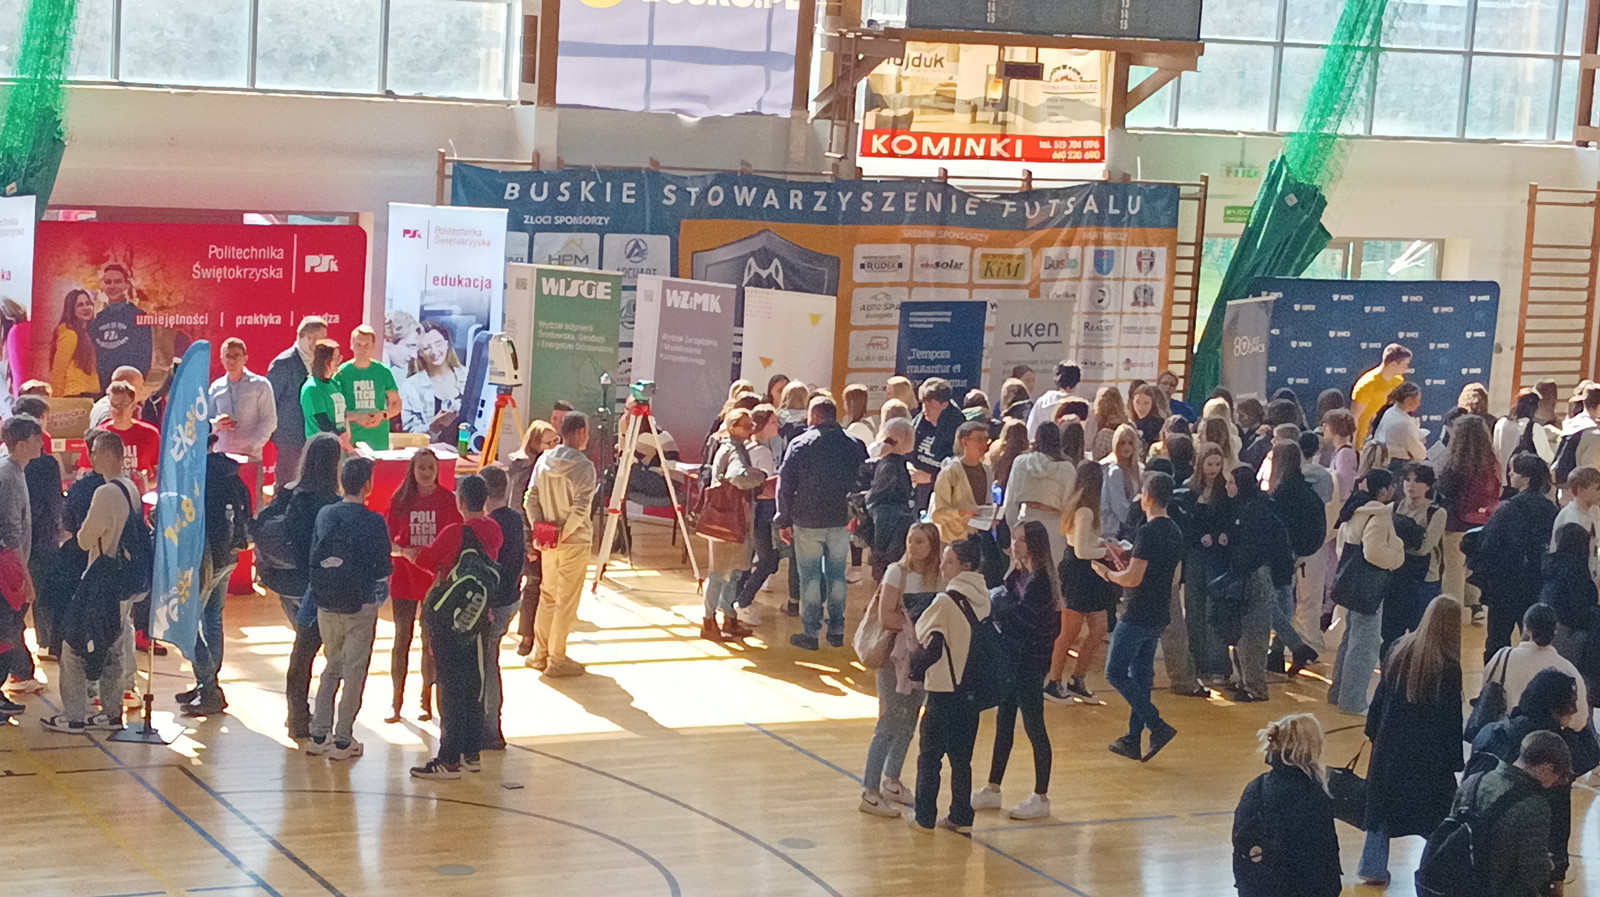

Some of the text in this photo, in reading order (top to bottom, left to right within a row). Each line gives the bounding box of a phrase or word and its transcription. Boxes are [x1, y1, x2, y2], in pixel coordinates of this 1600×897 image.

[871, 134, 1023, 158] KOMINKI
[504, 181, 1142, 218] BUSKIE STOWARZYSZENIE FUTSALU
[554, 215, 610, 226] SPONSORZY
[208, 245, 284, 260] Politechnika
[547, 254, 589, 266] HPM
[191, 261, 283, 283] Świętokrzyska
[432, 273, 492, 291] edukacja
[136, 312, 209, 328] umiejętności
[236, 311, 282, 327] praktyka
[1010, 322, 1059, 337] uken
[411, 511, 436, 523] POLI
[409, 523, 437, 535] TECH
[411, 535, 435, 546] NIKA
